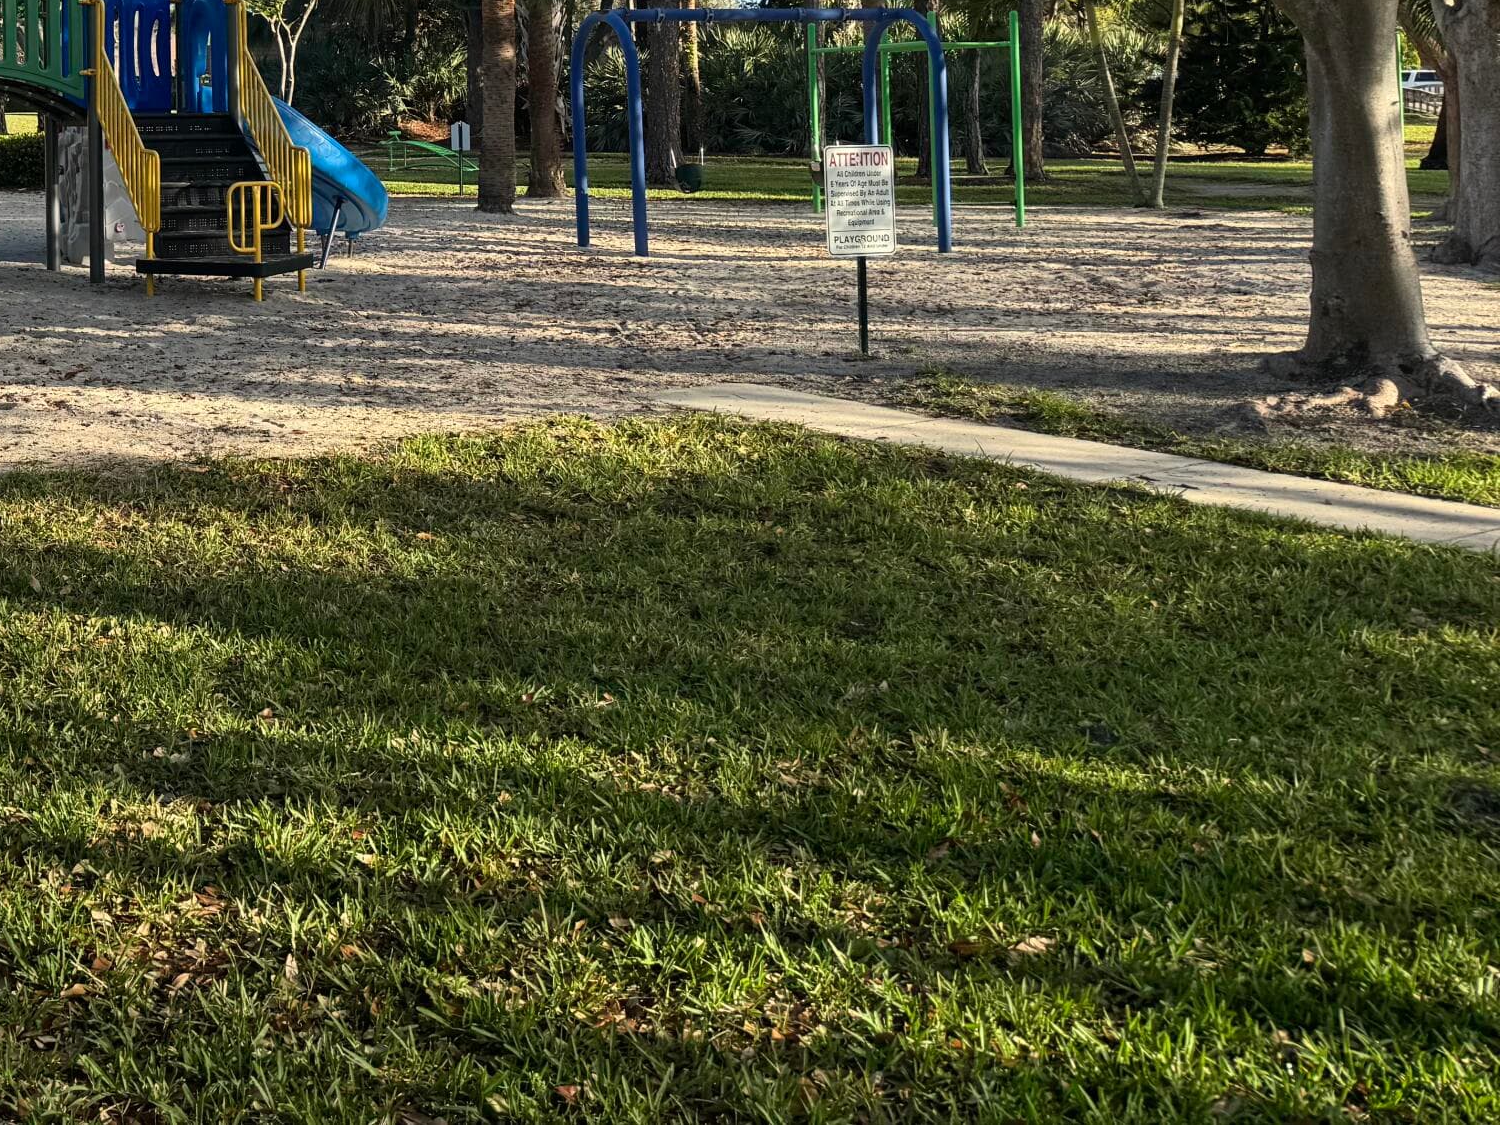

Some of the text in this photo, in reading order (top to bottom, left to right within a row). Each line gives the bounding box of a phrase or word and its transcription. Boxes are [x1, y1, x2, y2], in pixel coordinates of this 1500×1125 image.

[830, 152, 888, 167] ATTENTION
[857, 180, 867, 188] Age
[831, 190, 859, 198] Supervised
[876, 199, 890, 207] Using
[848, 218, 874, 226] Equipment
[834, 234, 889, 244] PLAYGROUND
